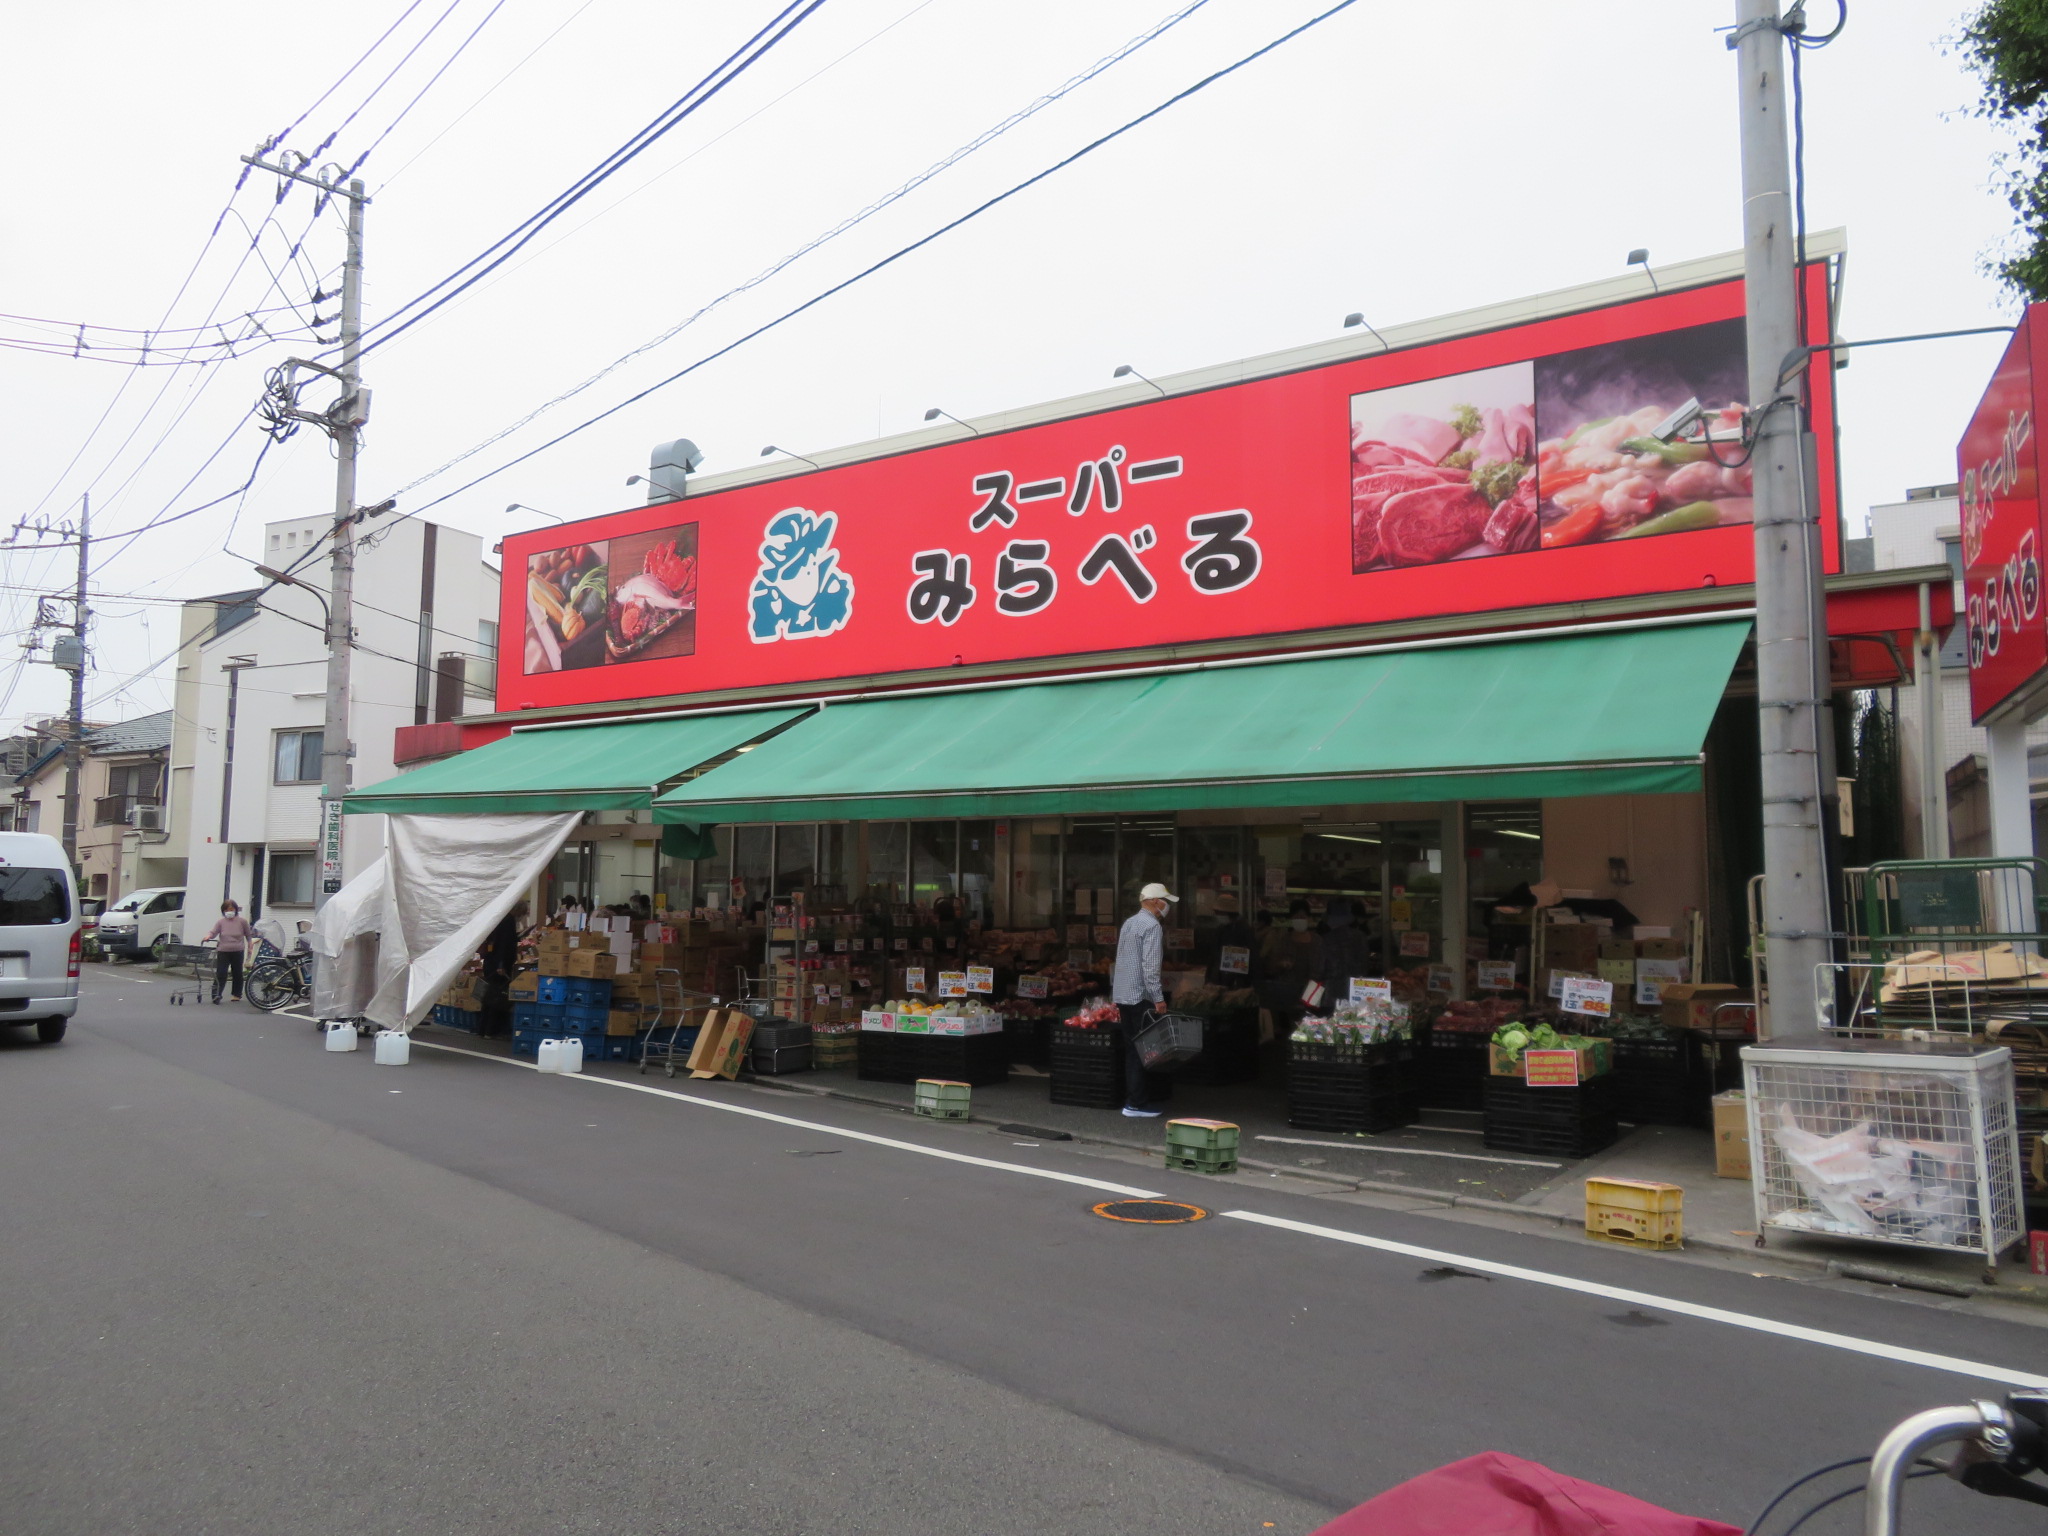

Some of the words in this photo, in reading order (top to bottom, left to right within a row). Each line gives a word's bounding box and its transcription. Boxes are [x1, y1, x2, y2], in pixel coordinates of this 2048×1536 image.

[970, 446, 1183, 532] スーパー
[1981, 411, 2029, 528] スーパー
[907, 509, 1262, 627] みらべる
[1970, 529, 2040, 669] みらべる
[327, 803, 340, 860] せき歯科医院
[868, 1017, 881, 1025] メロン
